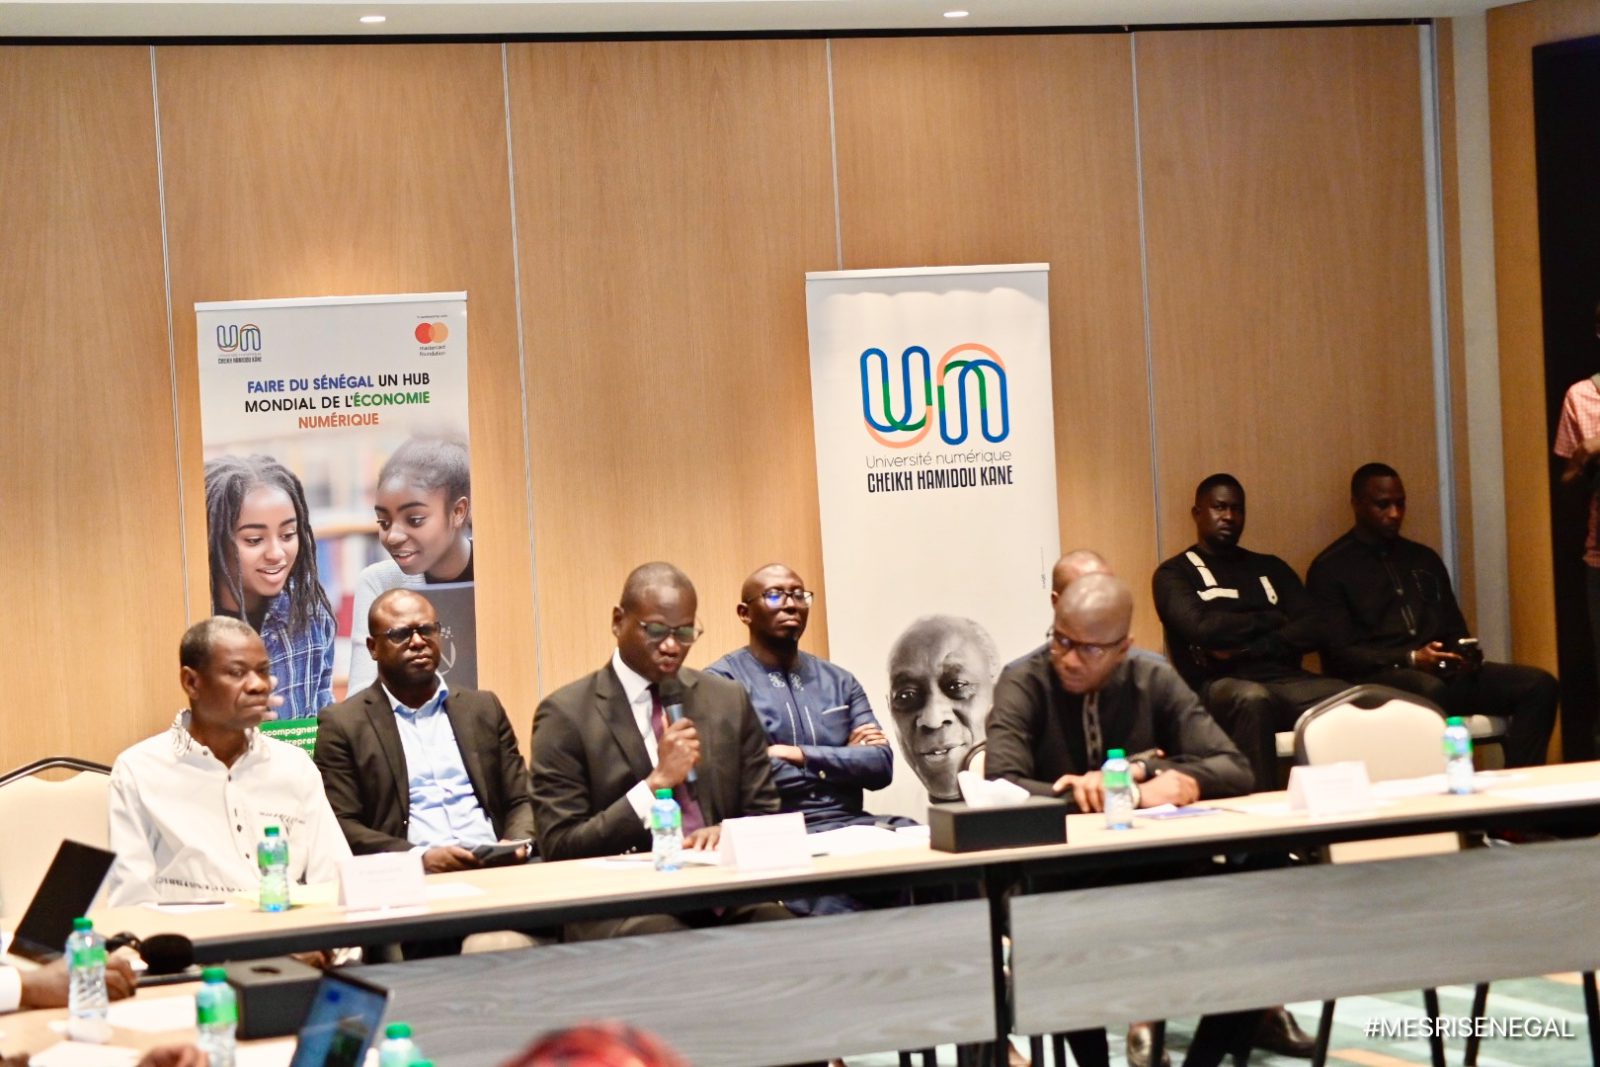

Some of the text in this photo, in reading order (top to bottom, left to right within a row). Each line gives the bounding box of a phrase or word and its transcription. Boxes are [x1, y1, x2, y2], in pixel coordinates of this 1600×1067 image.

[247, 372, 430, 394] FAIRE DU SÉNÉGAL UN HUB
[245, 391, 430, 413] MONDIAL DE L'ÉCONOMIE
[298, 412, 379, 429] NUMÉRIQUE
[865, 449, 1012, 469] Université numérique
[867, 465, 1013, 493] CHEIKH HAMIDOU KANE
